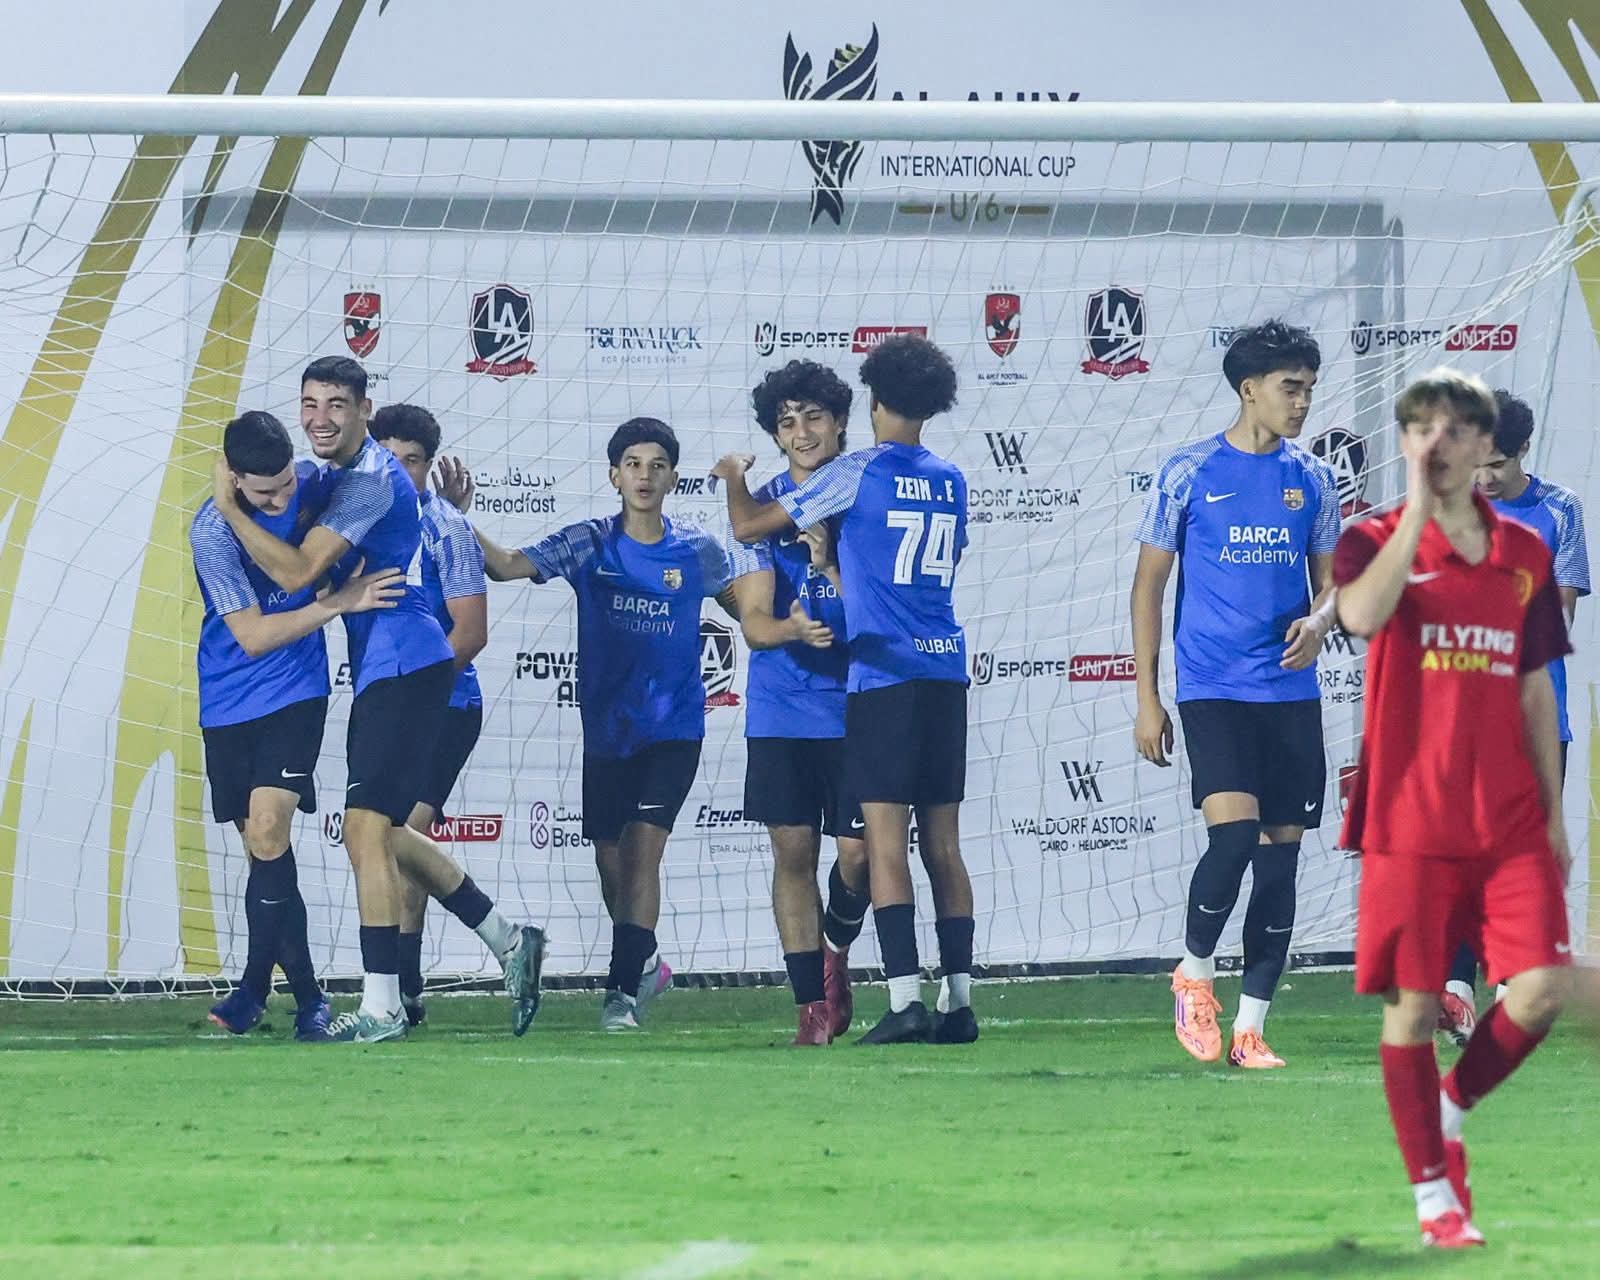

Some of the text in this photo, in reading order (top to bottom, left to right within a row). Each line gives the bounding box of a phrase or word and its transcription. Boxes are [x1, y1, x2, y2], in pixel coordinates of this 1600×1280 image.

[881, 156, 1076, 177] INTERNATIONAL CUP
[950, 194, 1000, 221] U16
[780, 332, 850, 348] SPORTS
[1375, 329, 1513, 346] SPORTS UNITED
[894, 476, 931, 500] ZEIN
[945, 480, 954, 503] E
[969, 489, 1013, 507] DORF
[475, 492, 556, 513] Breadfast
[1229, 526, 1290, 546] BARÇA
[887, 510, 957, 587] 74
[1219, 546, 1299, 567] Academy
[613, 595, 670, 618] BARÇA
[1421, 623, 1515, 655] FLYING
[516, 652, 578, 680] POW
[997, 660, 1136, 677] SPORTS UNITED
[431, 821, 497, 836] UNITED
[1011, 816, 1155, 835] WALDORF ASTORIA
[1040, 840, 1068, 852] CAIRO
